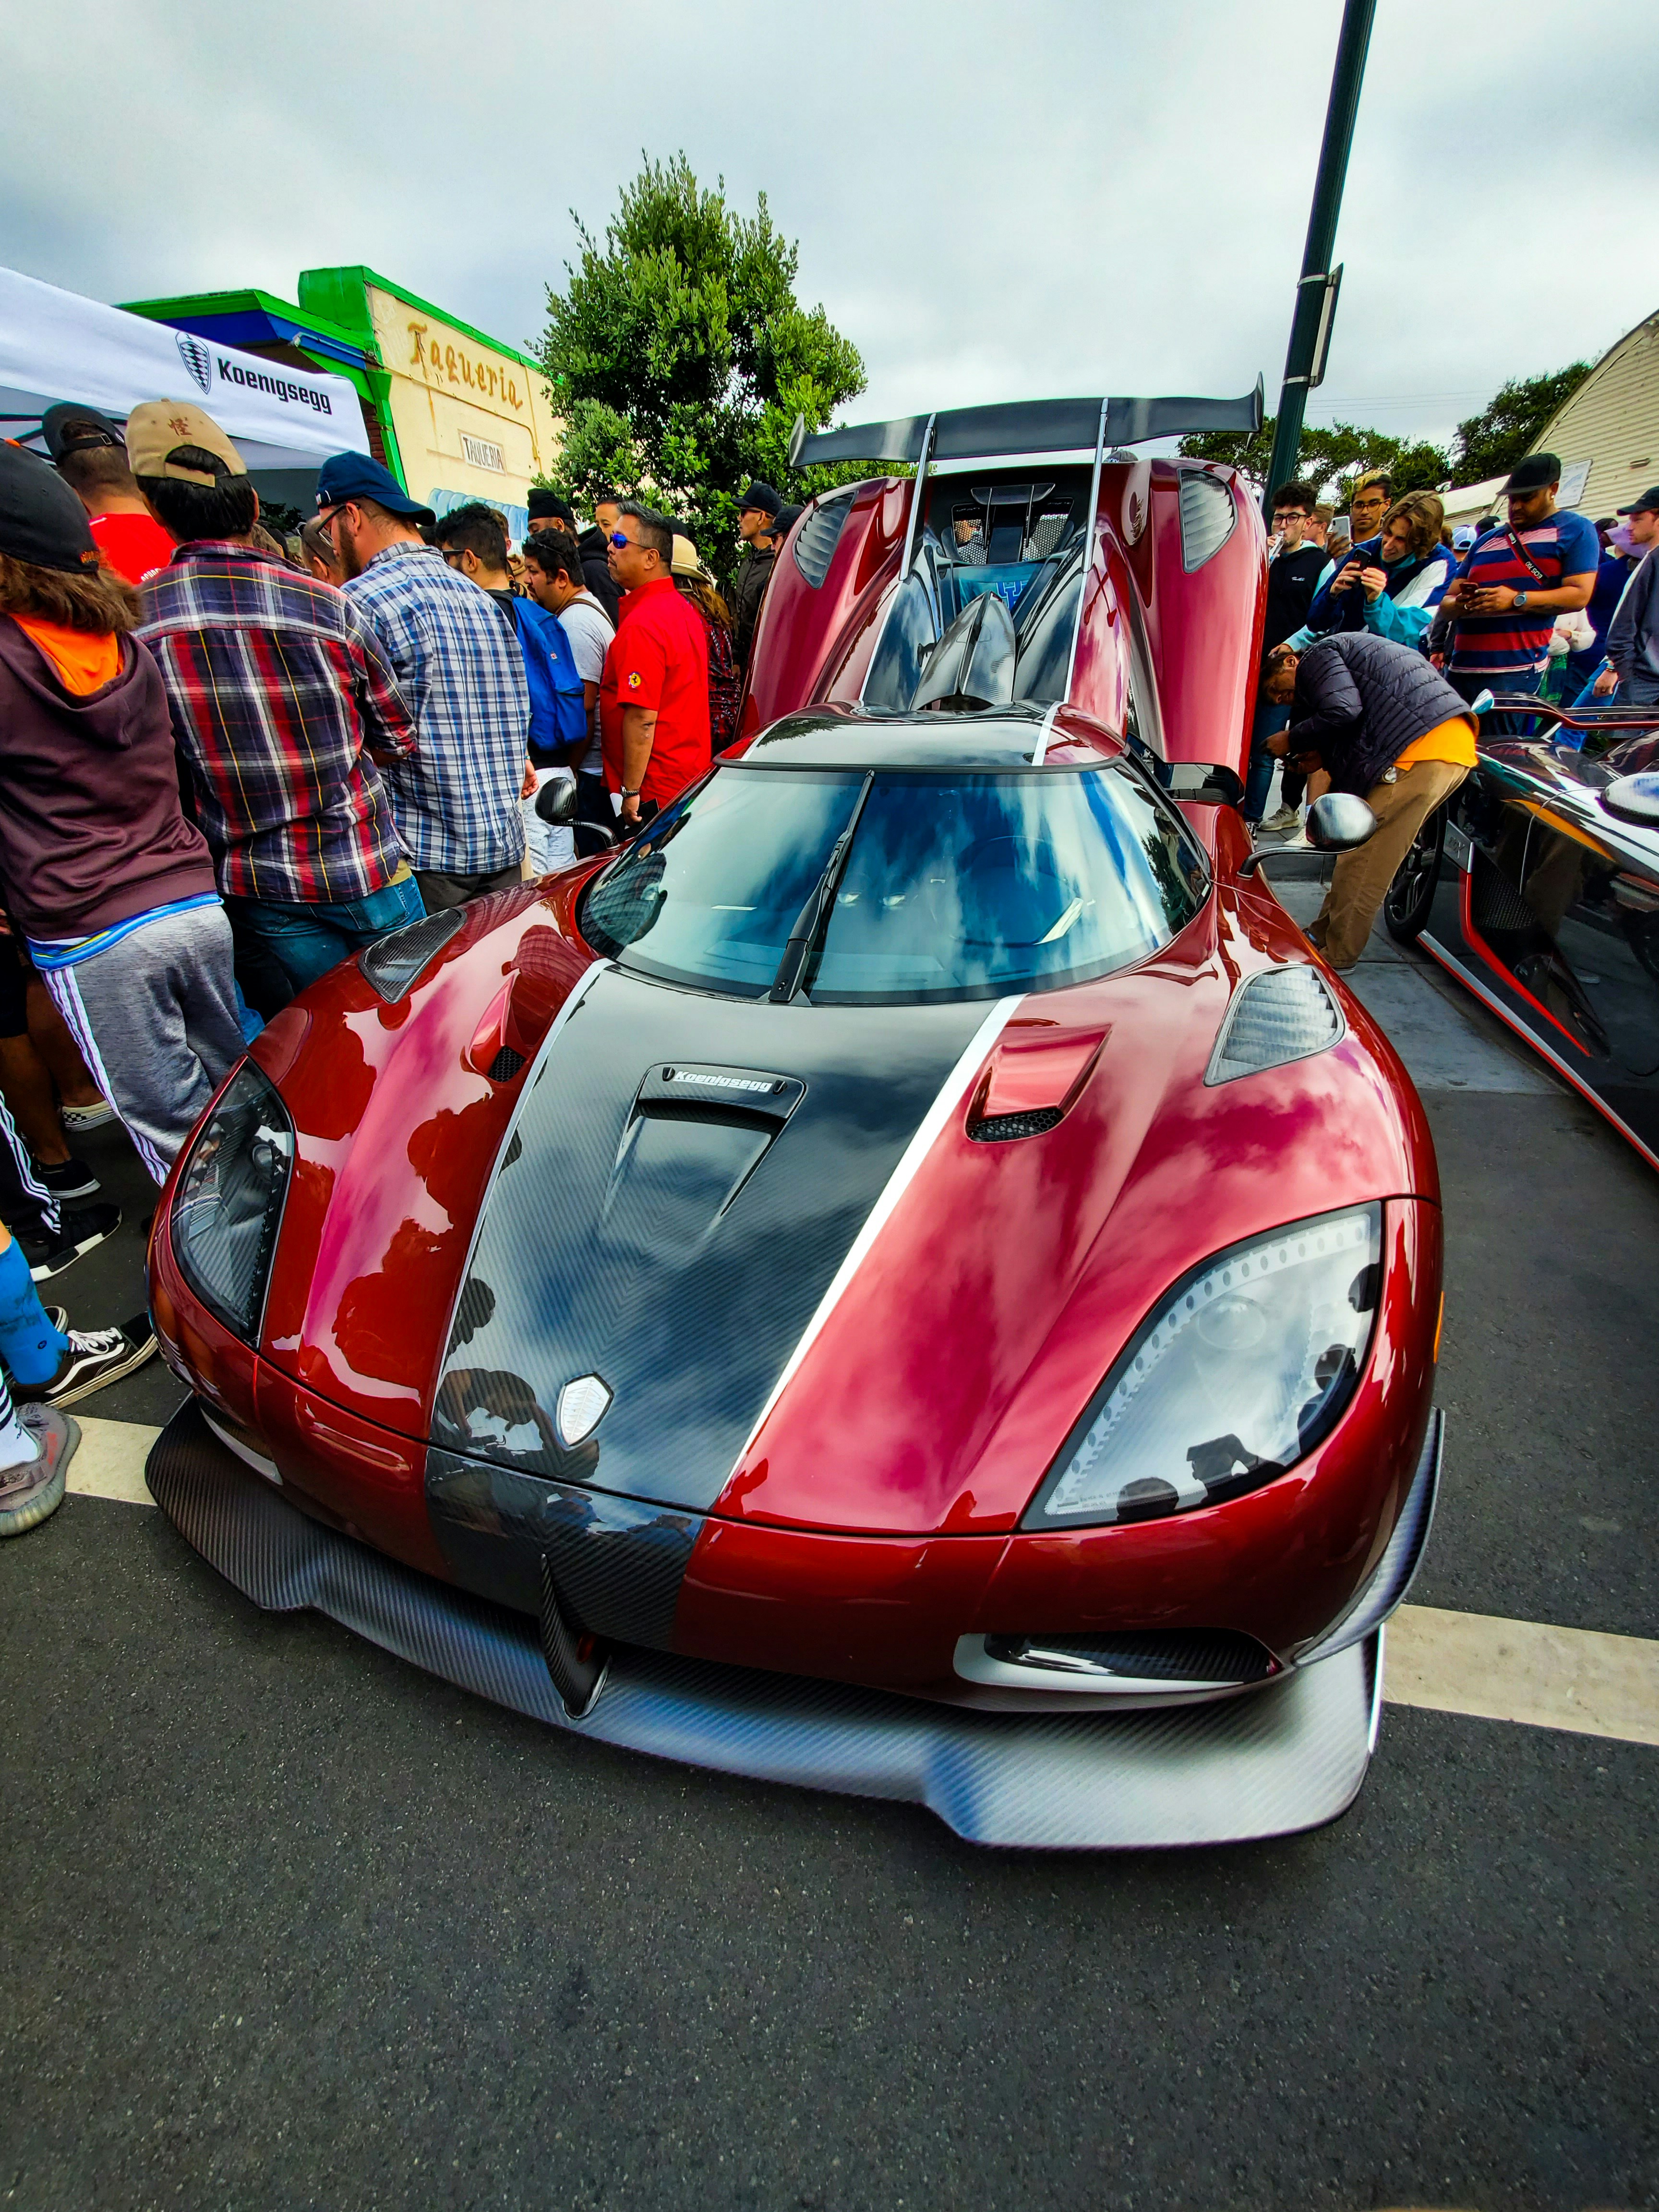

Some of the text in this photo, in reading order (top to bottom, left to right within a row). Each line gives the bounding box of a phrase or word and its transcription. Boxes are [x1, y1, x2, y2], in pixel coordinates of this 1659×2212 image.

[408, 322, 523, 410] Taqueria
[217, 357, 332, 415] Koenigsegg
[463, 436, 504, 469] TAQUERIA
[1531, 568, 1543, 579] EOS
[673, 1071, 773, 1093] Koenigsegg
